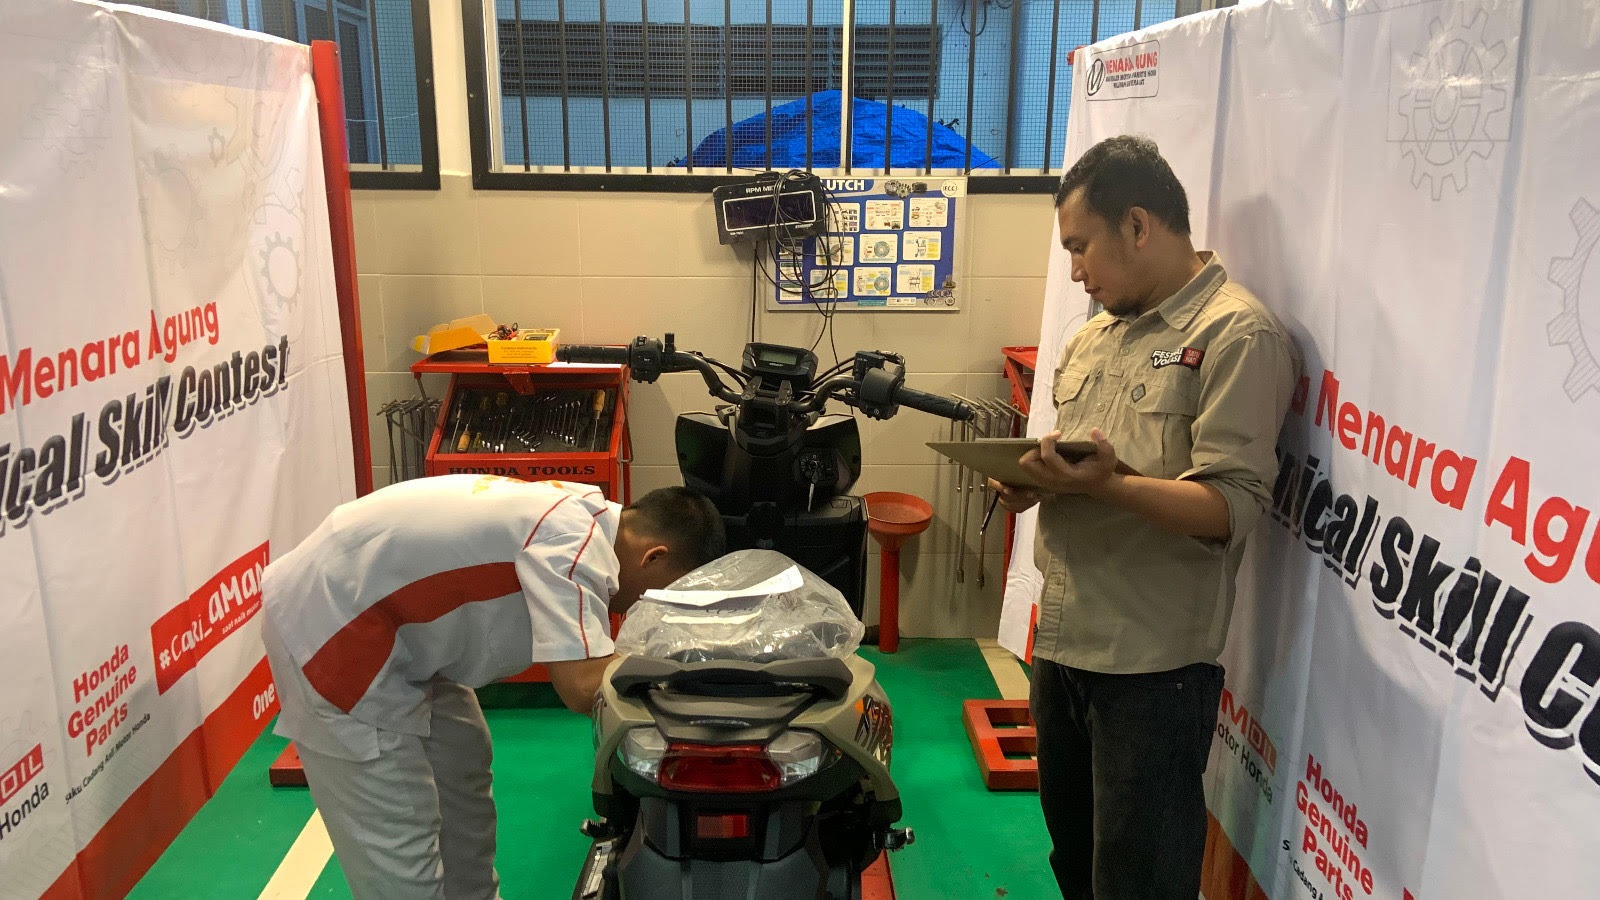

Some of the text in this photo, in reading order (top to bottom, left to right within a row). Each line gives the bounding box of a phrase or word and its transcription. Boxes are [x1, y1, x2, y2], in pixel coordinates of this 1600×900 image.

[0, 302, 220, 415] Menara Agung
[174, 335, 289, 438] Contest
[448, 465, 595, 477] HONDA TOOLS
[1370, 516, 1533, 702] Skill
[68, 665, 136, 738] Genuine
[73, 644, 129, 704] Honda
[253, 683, 275, 720] One
[86, 702, 128, 757] Parts
[0, 782, 49, 840] Honda
[1297, 780, 1373, 895] Genuine
[1306, 752, 1368, 850] Honda
